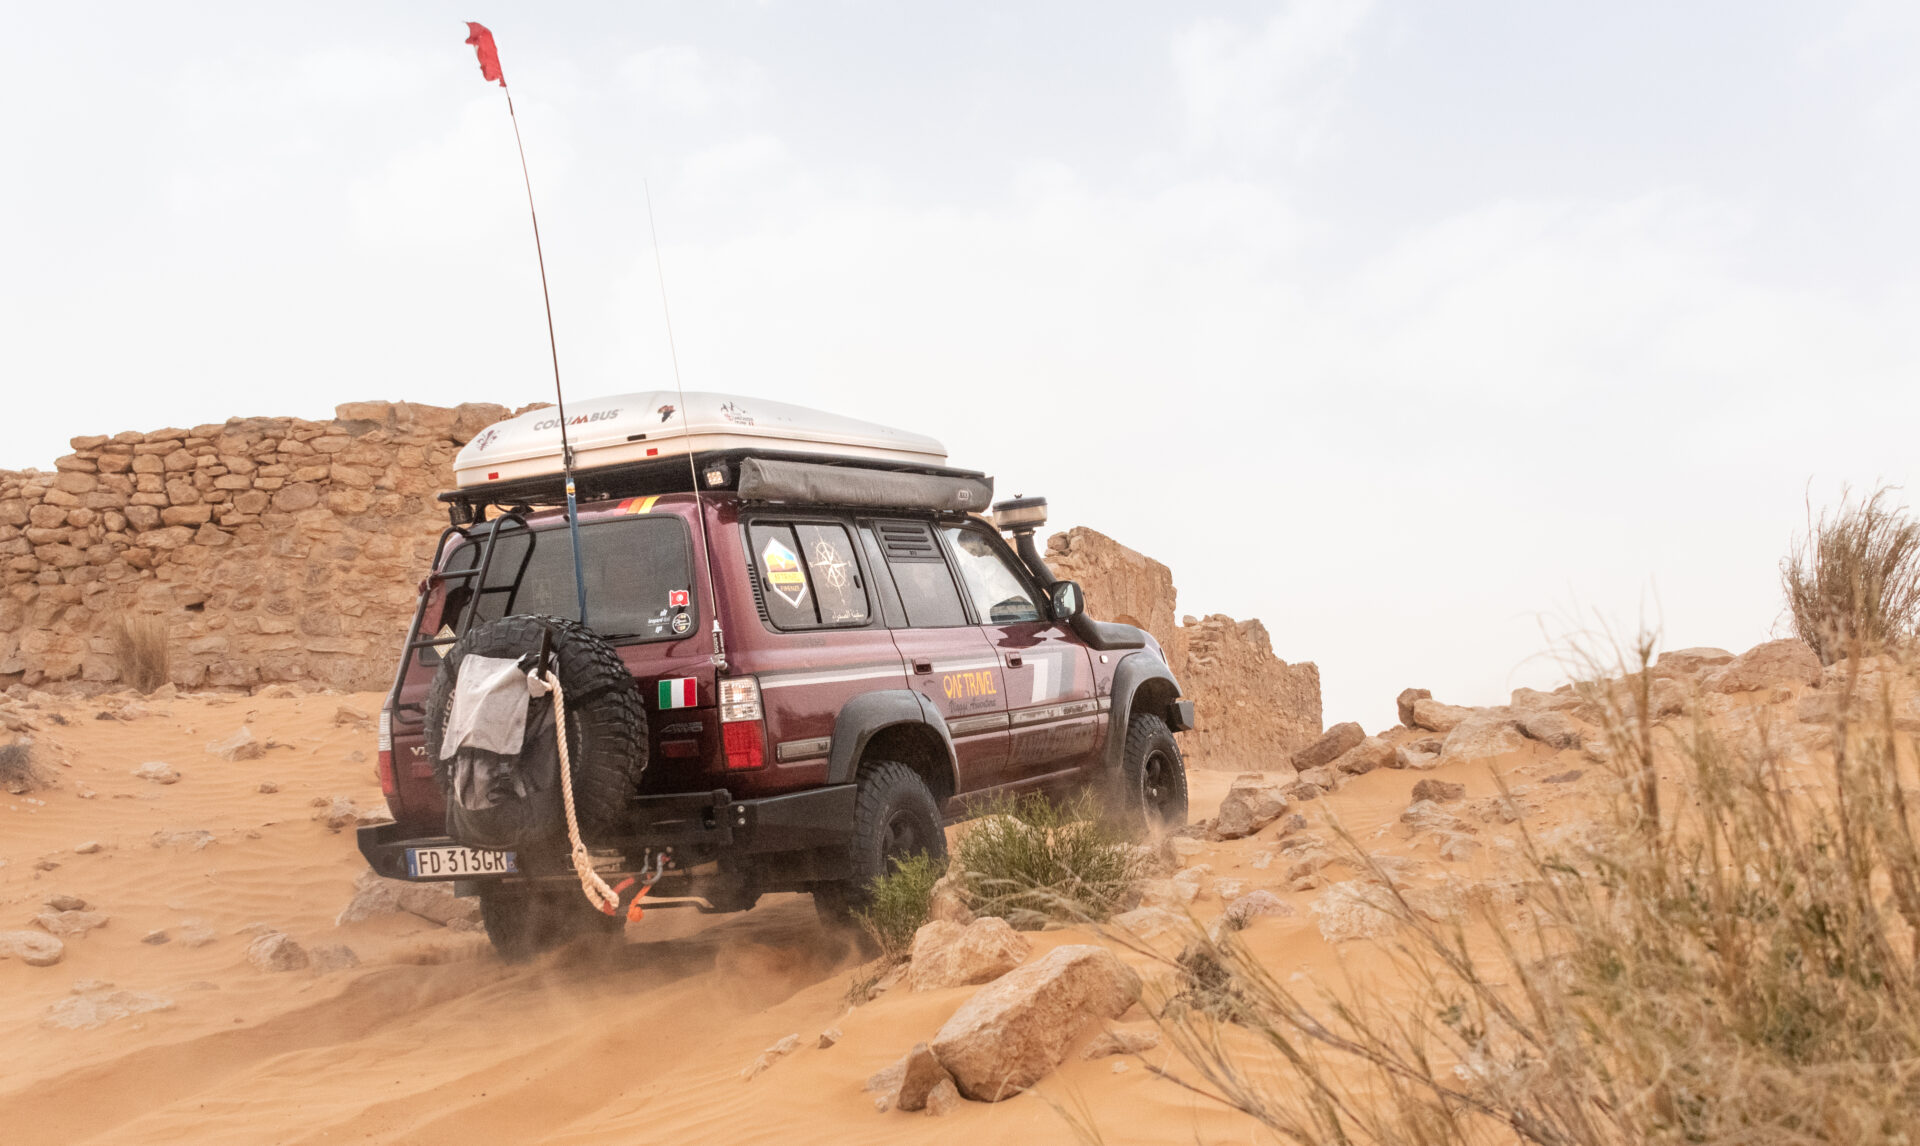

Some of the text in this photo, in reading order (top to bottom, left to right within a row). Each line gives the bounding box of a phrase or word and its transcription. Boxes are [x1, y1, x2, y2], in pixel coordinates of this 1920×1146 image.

[533, 409, 619, 431] COLUMBUS
[963, 671, 997, 697] TRAVEL
[418, 851, 441, 874] FD
[447, 849, 505, 873] 313GR
